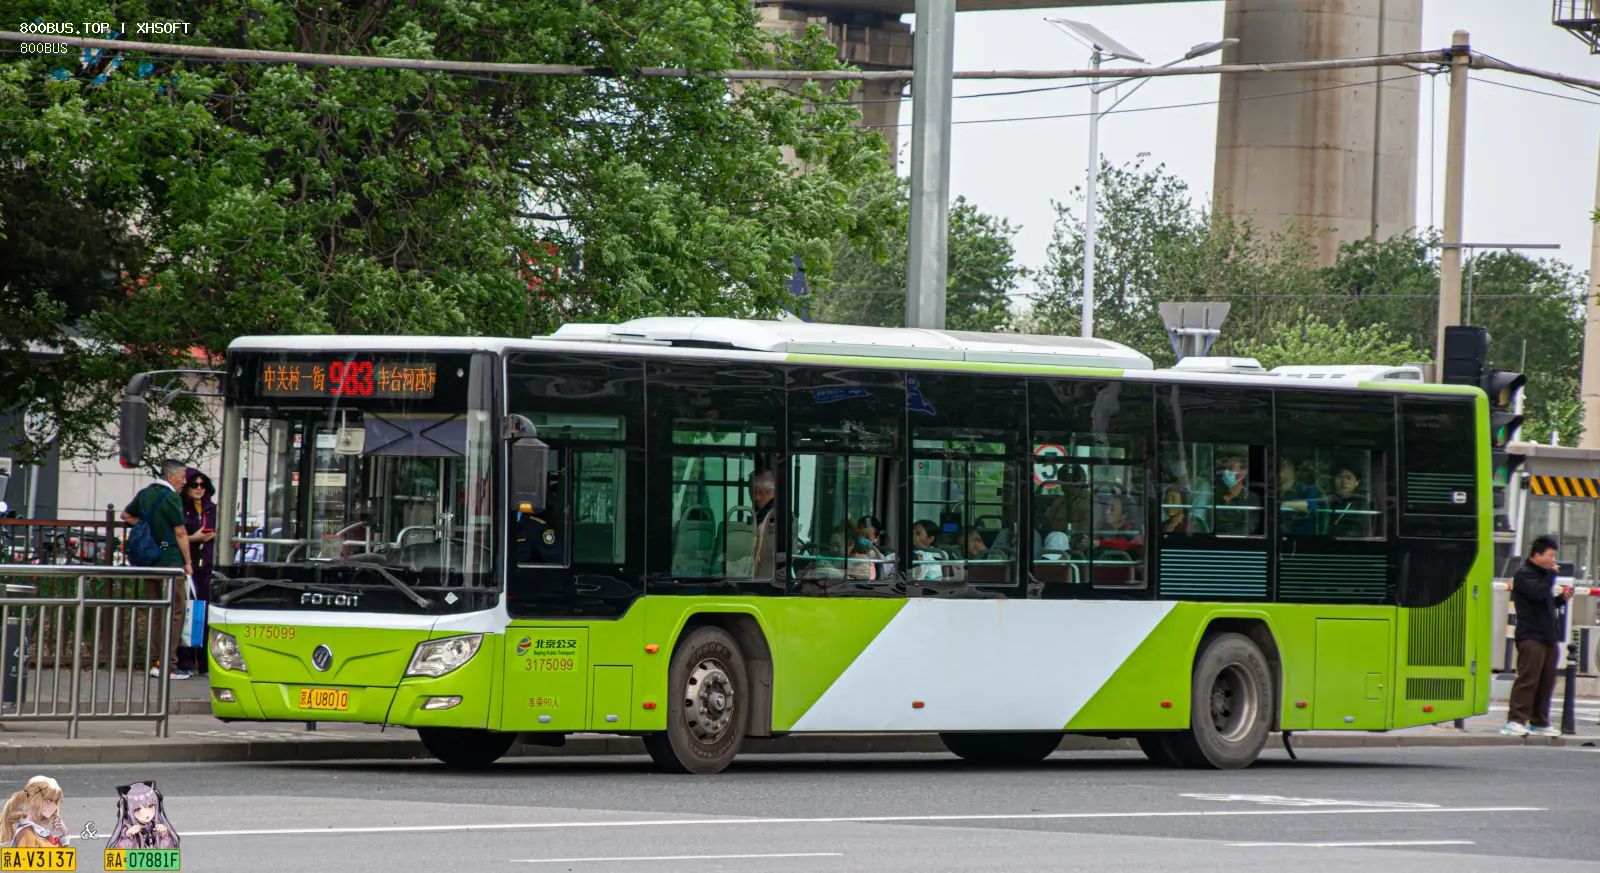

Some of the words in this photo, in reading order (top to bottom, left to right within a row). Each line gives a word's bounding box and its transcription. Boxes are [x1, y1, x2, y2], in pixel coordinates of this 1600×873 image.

[263, 365, 326, 391] 中关村一街
[329, 361, 373, 396] 983
[300, 592, 358, 607] FOTON
[243, 625, 296, 639] 3175099
[534, 639, 577, 649] 北京公交
[525, 658, 574, 671] 3175099
[528, 696, 560, 708] 准乘90人
